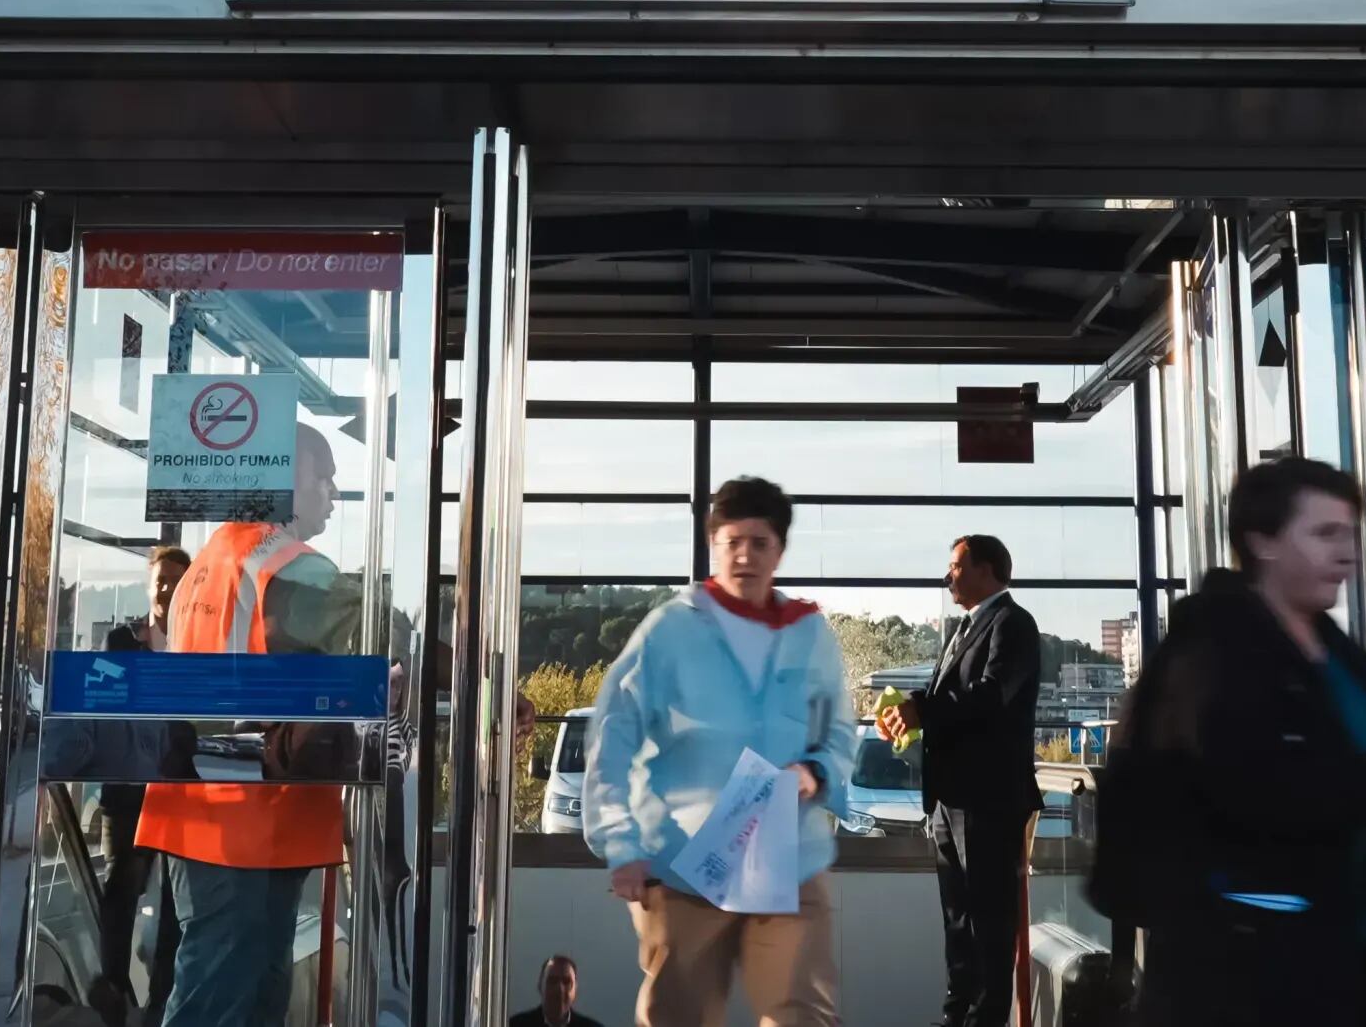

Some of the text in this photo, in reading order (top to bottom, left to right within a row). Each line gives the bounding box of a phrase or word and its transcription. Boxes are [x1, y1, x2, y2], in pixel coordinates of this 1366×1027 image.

[97, 248, 135, 271] No
[142, 251, 219, 275] pasar
[236, 249, 272, 272] Do
[278, 250, 319, 272] not
[323, 251, 390, 273] enter
[153, 454, 291, 467] PROHIBIDO FUMAR
[182, 473, 260, 488] No smoking
